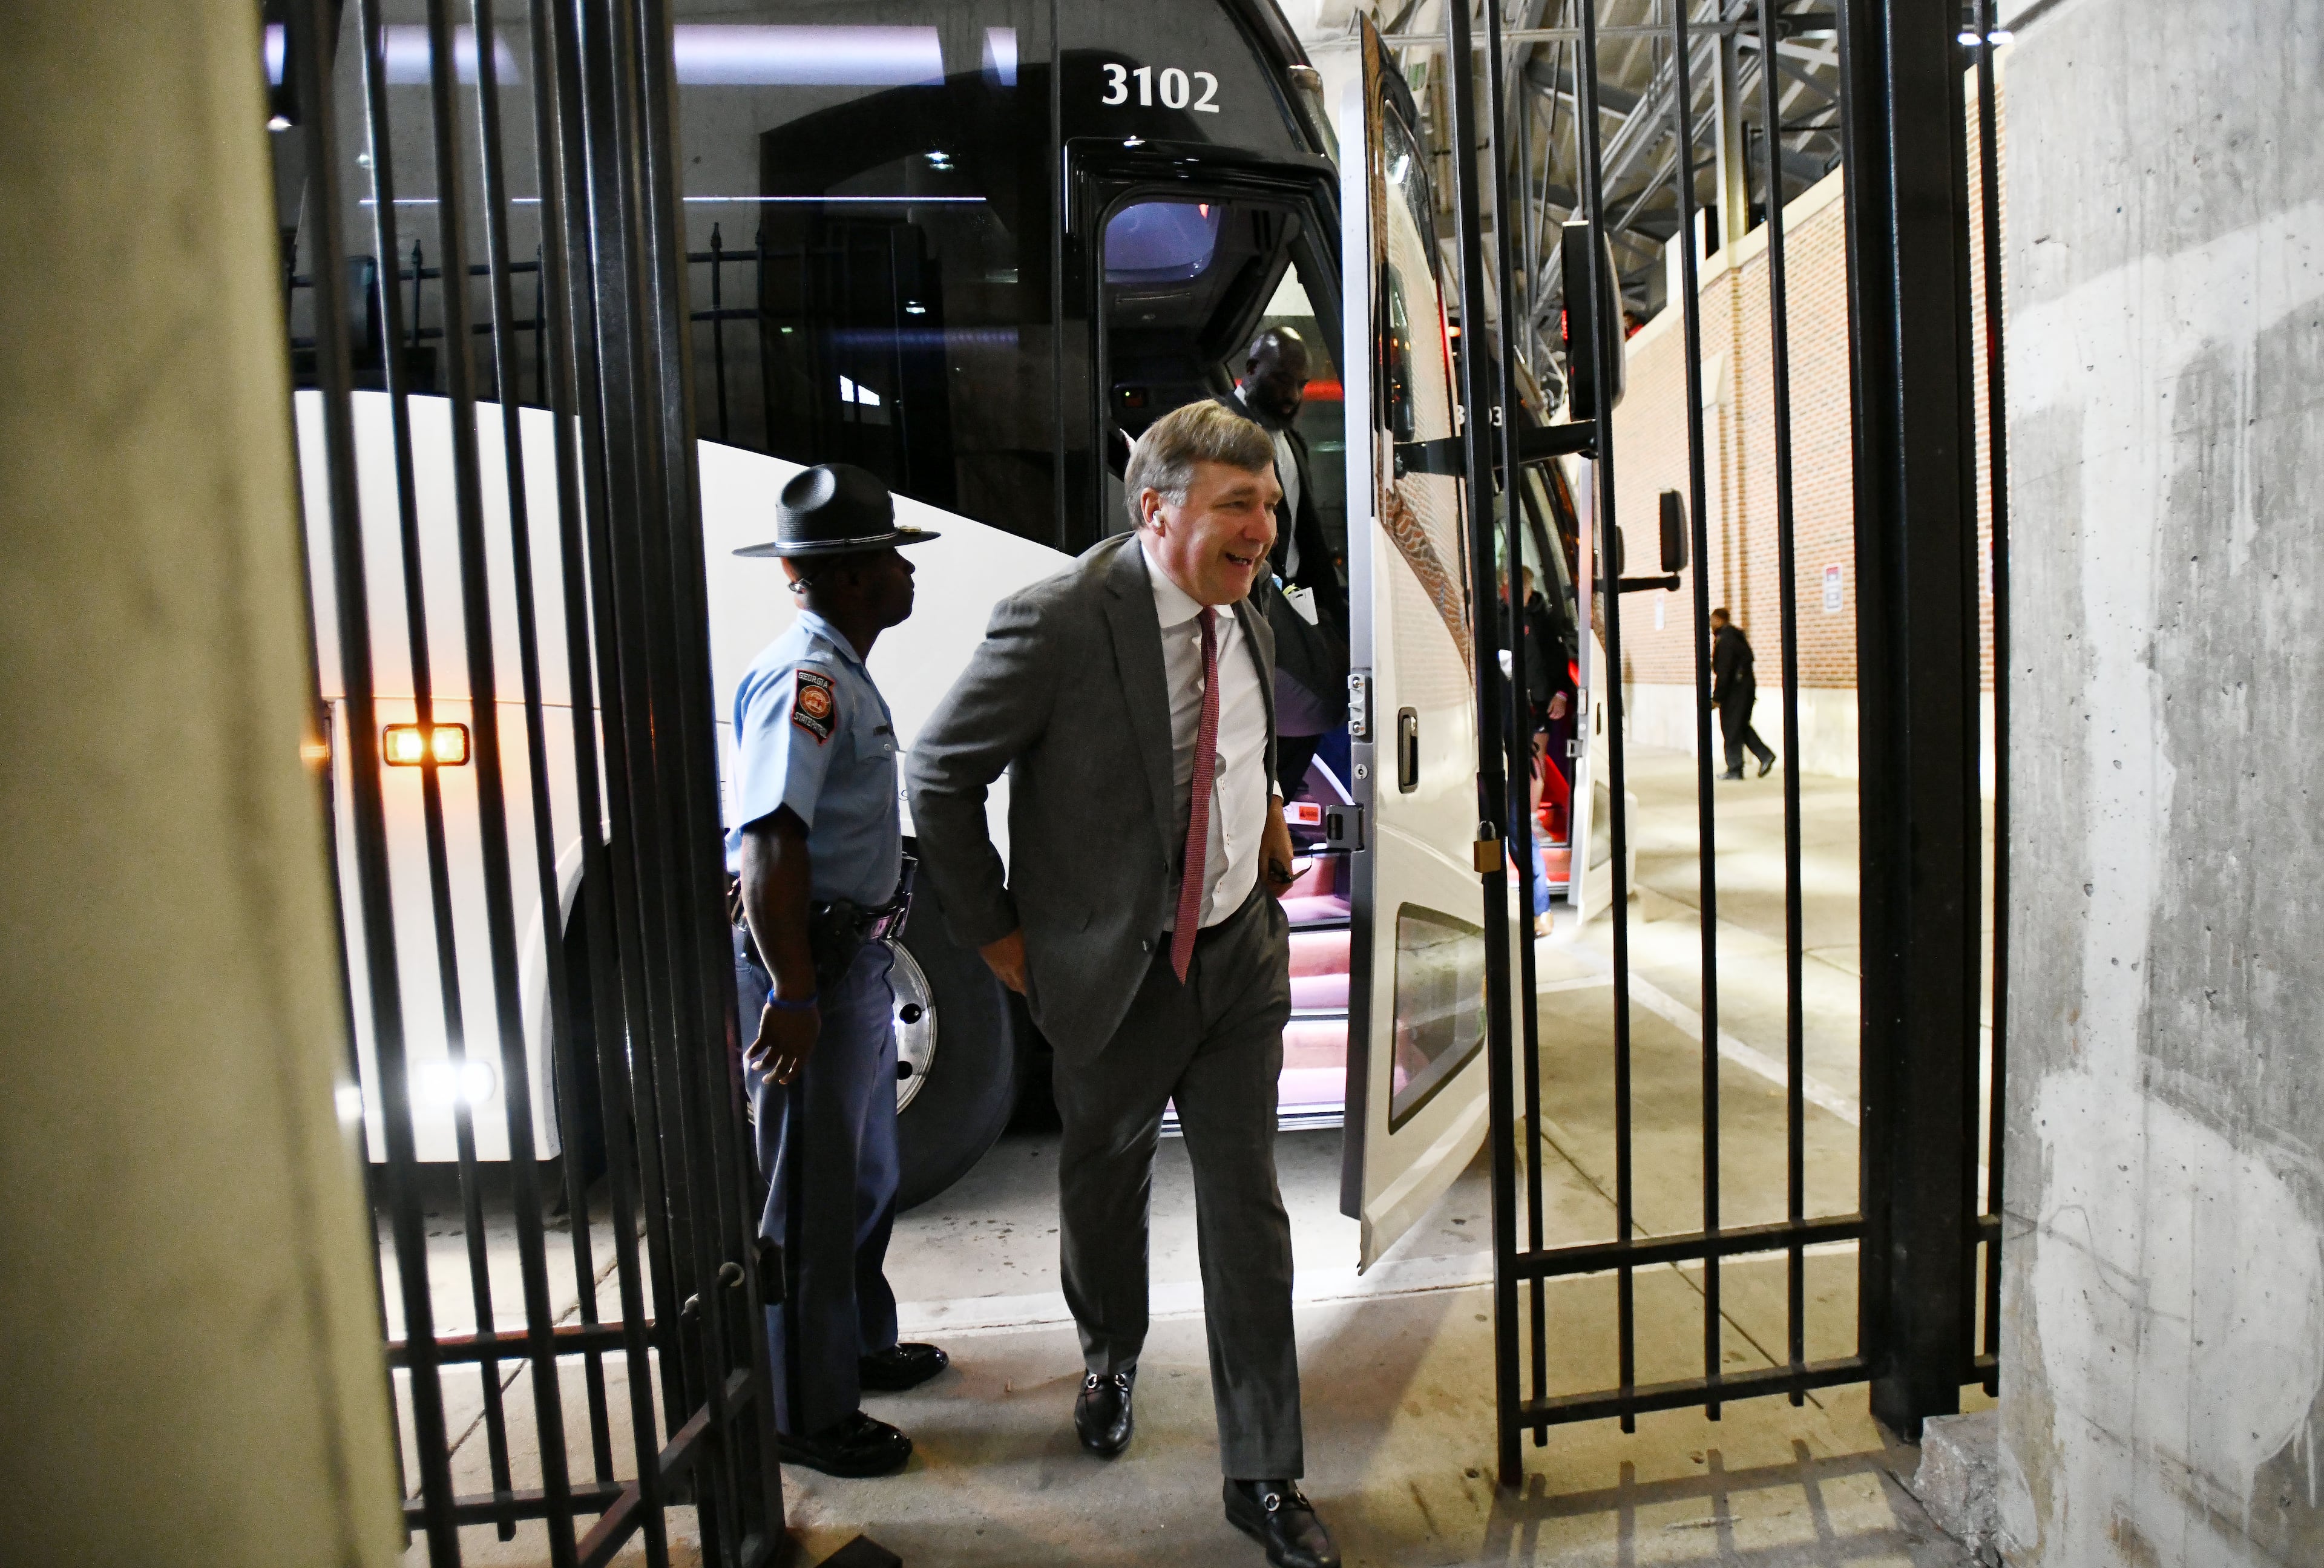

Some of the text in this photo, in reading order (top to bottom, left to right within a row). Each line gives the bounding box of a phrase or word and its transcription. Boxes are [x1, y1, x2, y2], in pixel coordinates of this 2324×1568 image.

[1101, 63, 1219, 113] 3102
[1457, 404, 1502, 427] 33
[798, 672, 829, 688] GEORGIA
[793, 712, 813, 727] STATE
